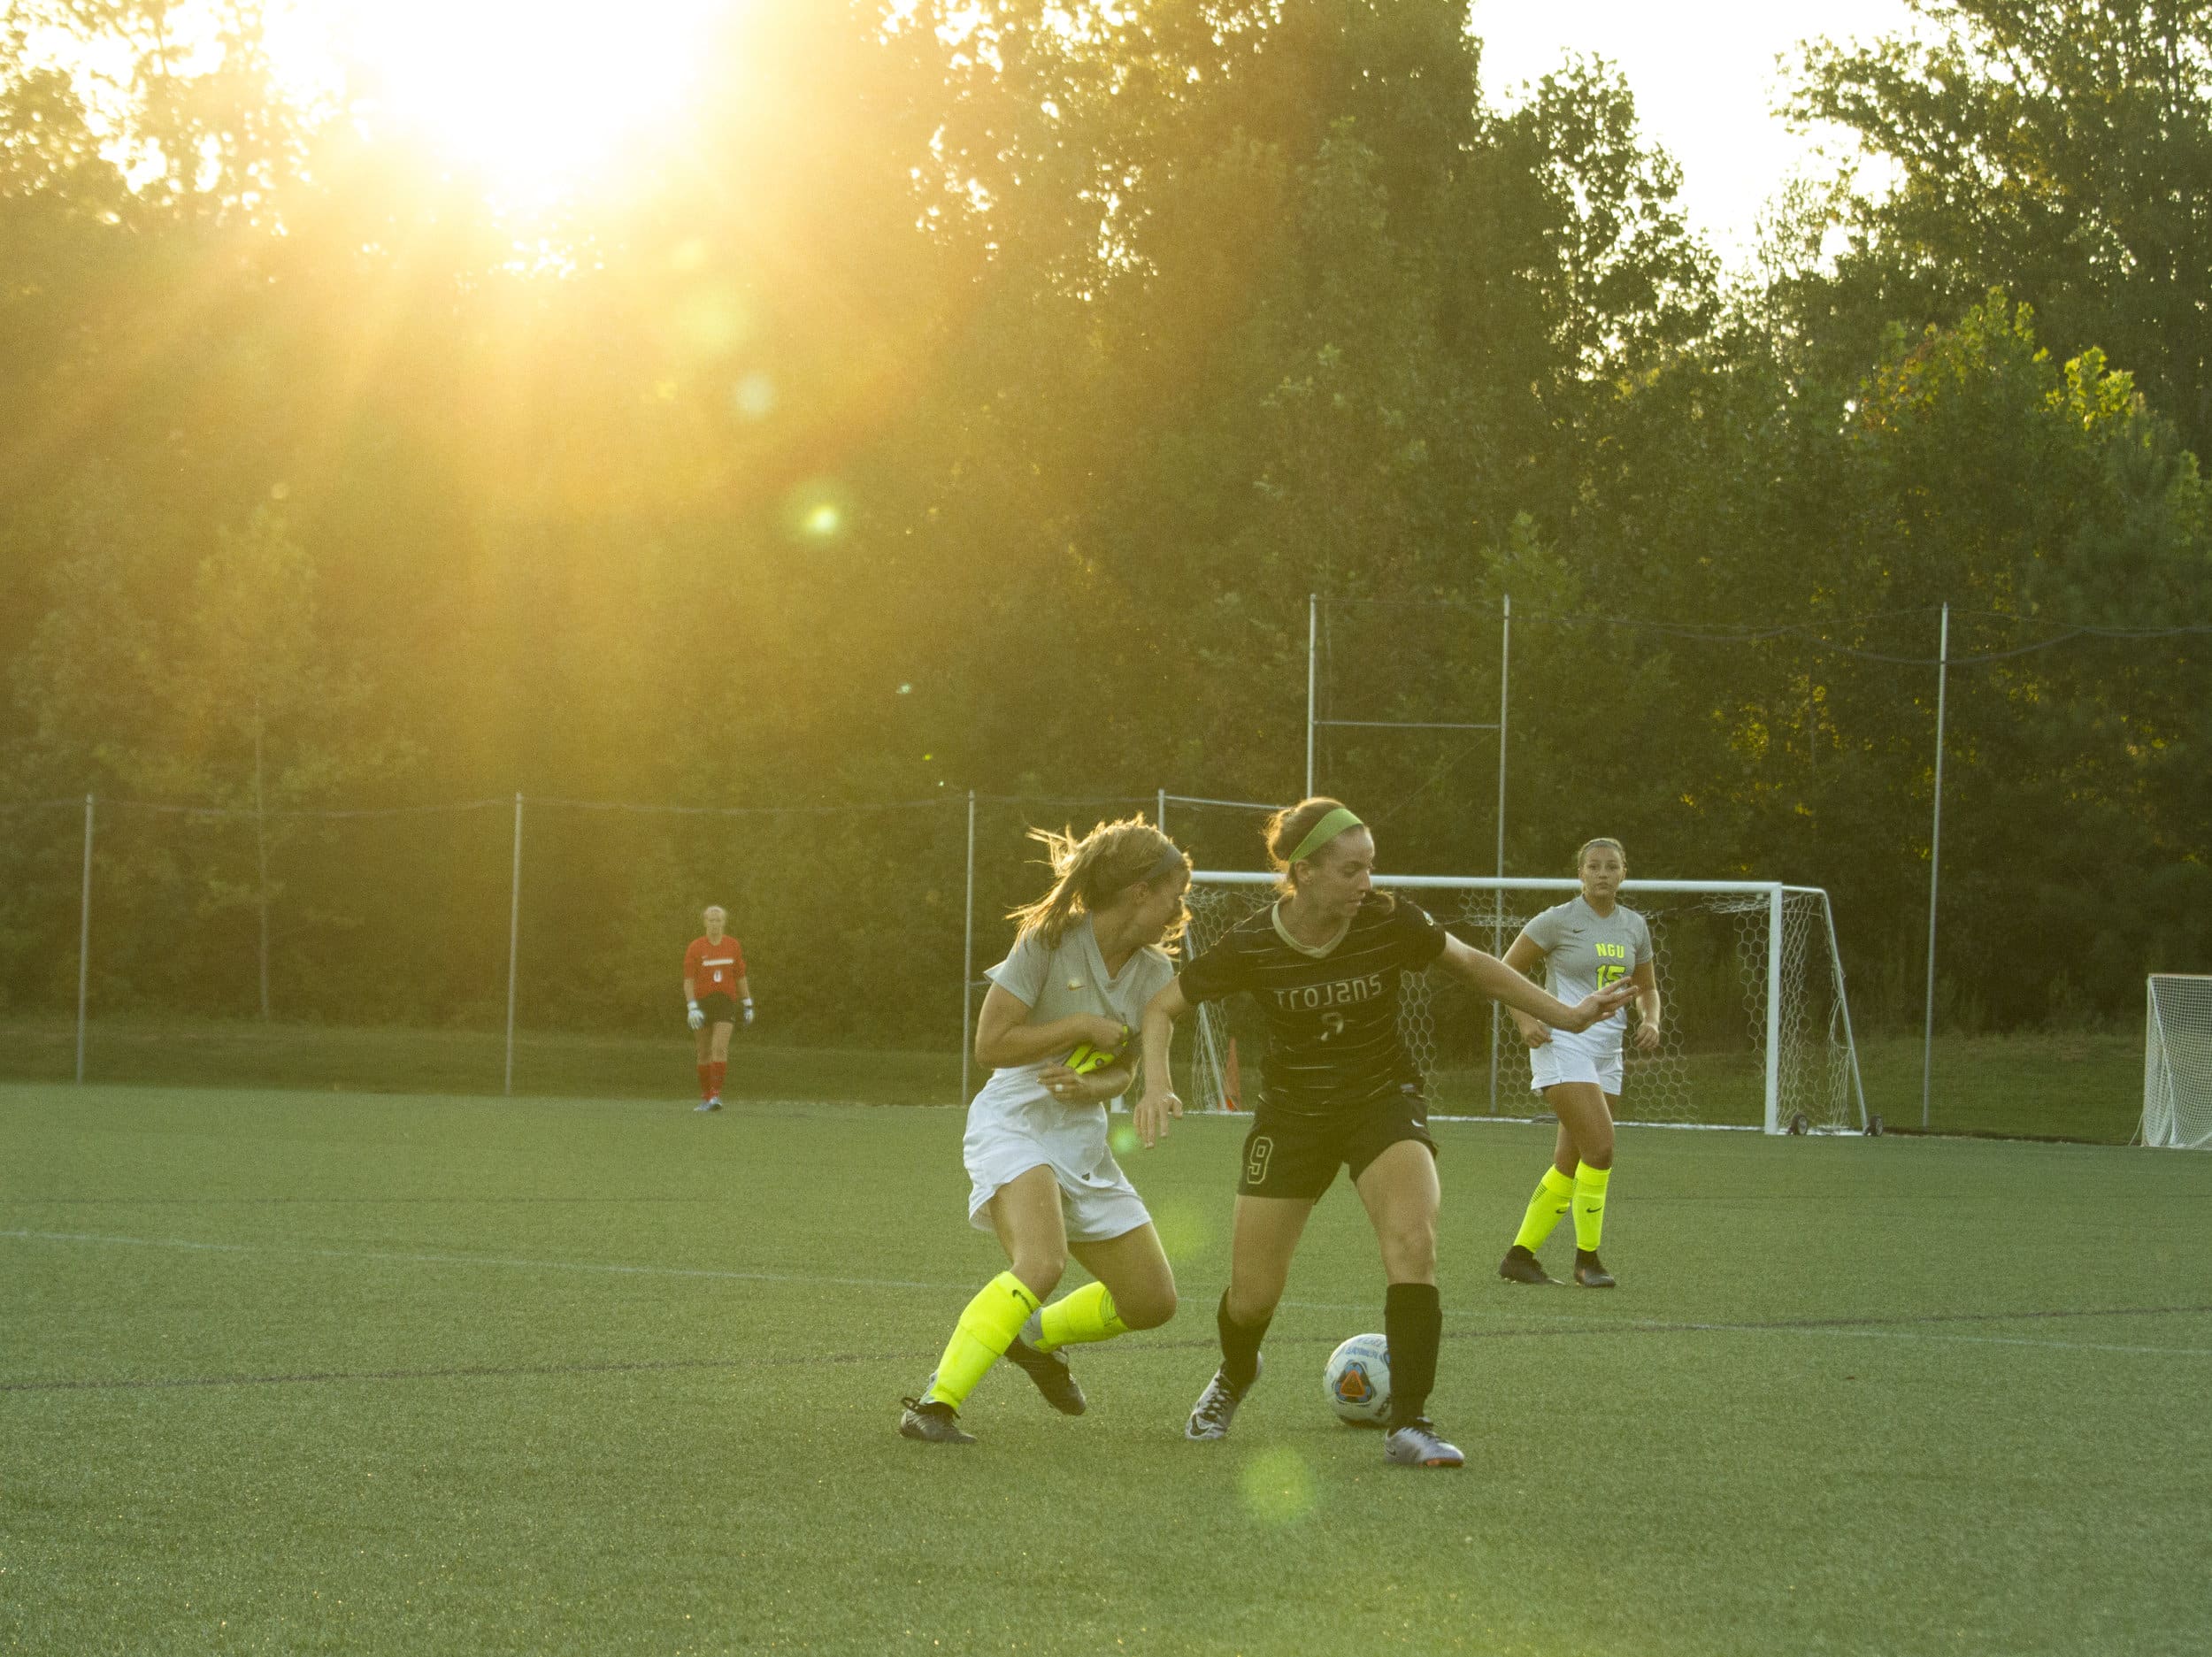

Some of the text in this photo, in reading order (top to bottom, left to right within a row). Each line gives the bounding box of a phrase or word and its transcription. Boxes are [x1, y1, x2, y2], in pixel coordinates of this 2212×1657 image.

[1595, 943, 1624, 958] NGU
[1596, 965, 1625, 991] 15
[1248, 1137, 1273, 1185] 9
